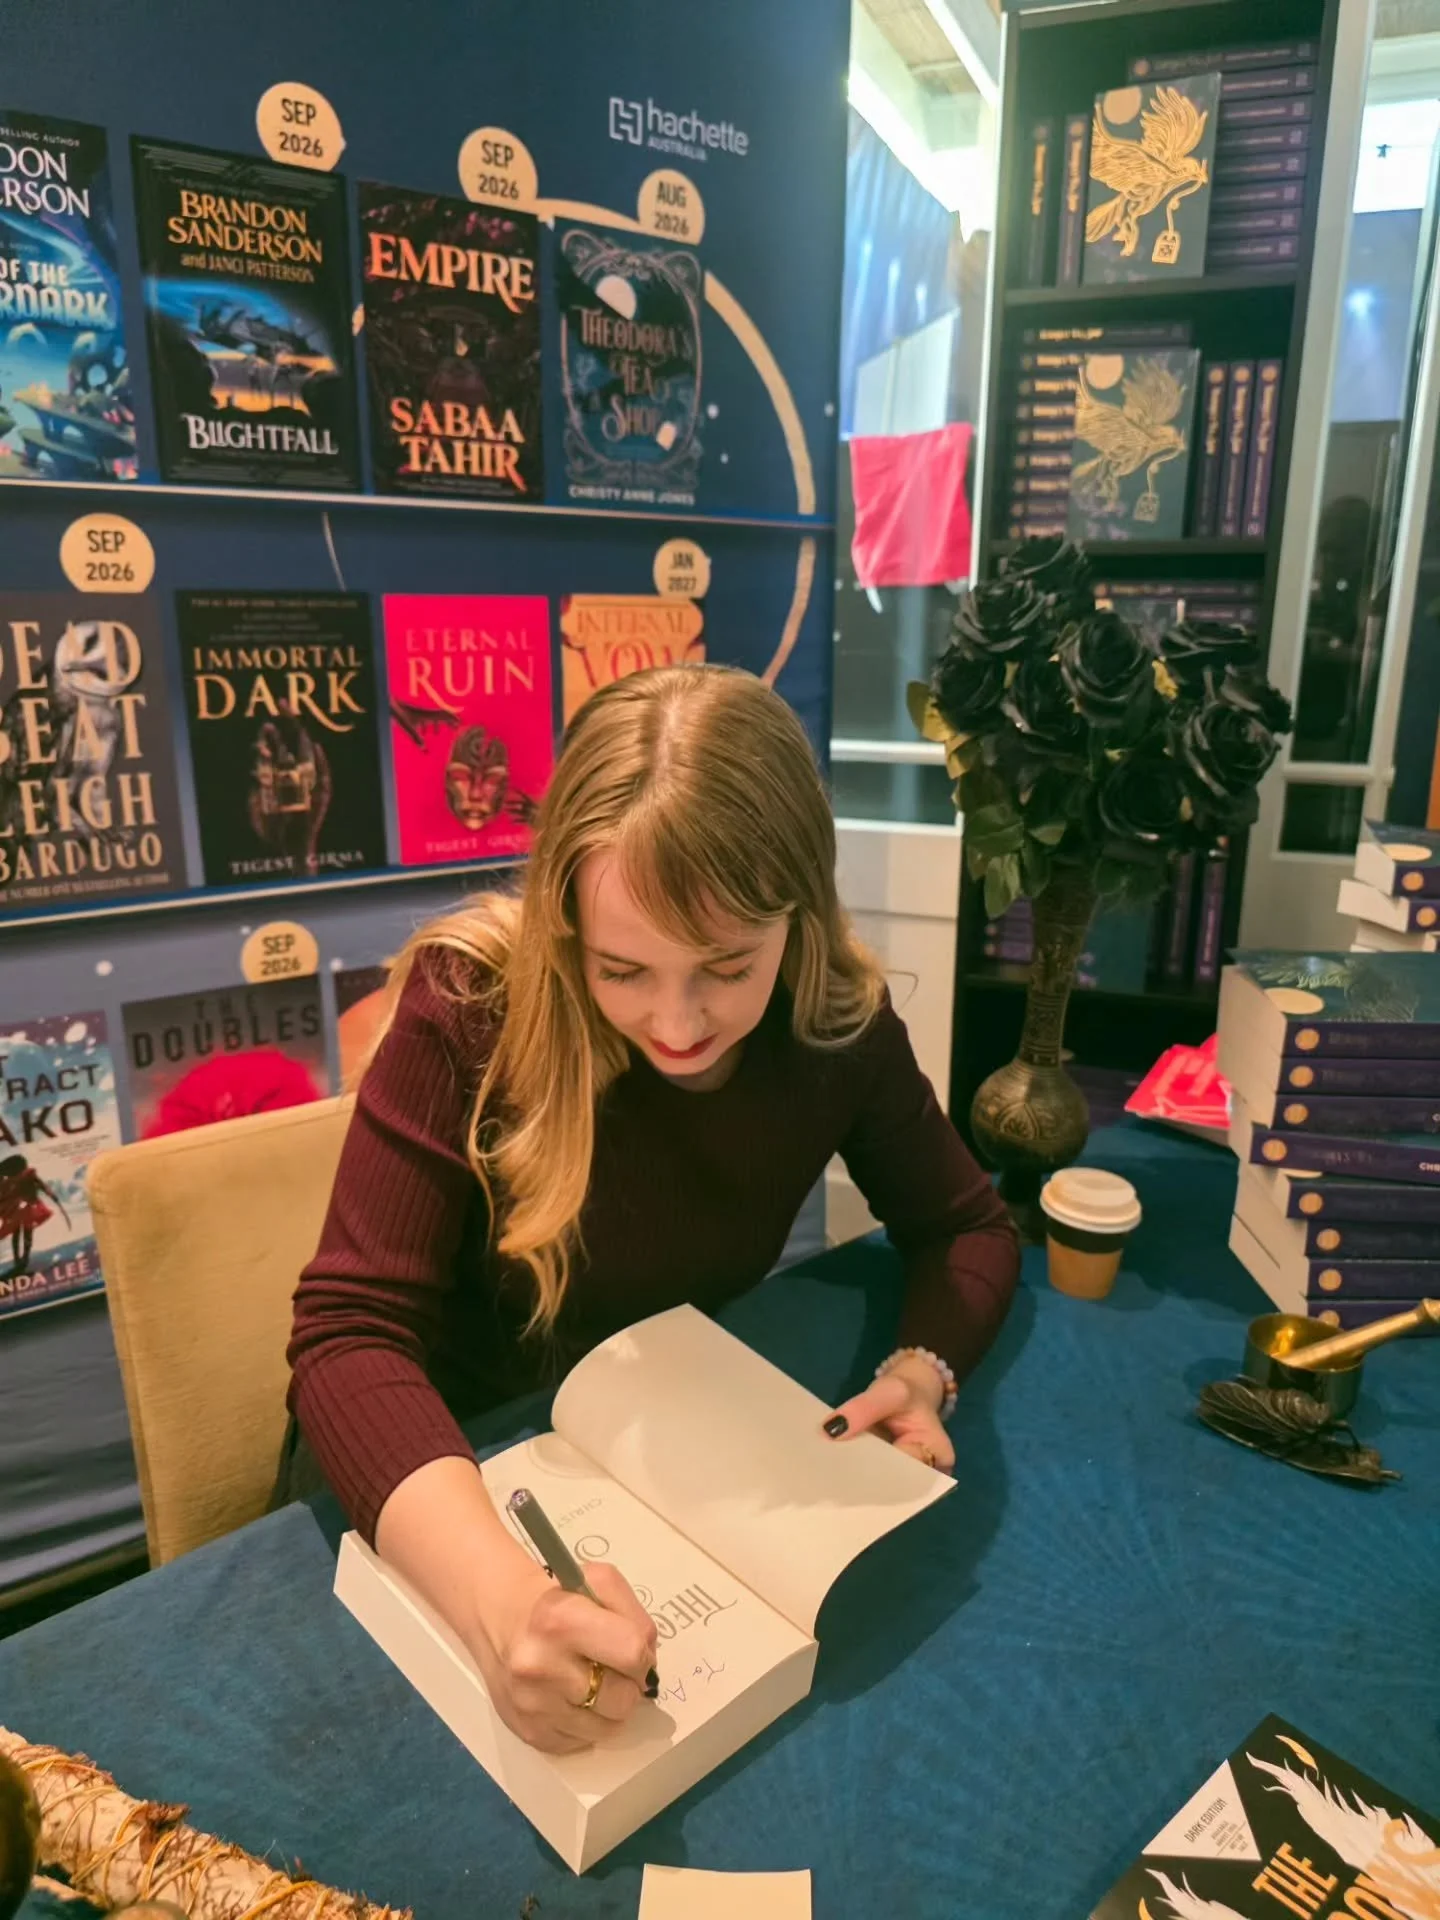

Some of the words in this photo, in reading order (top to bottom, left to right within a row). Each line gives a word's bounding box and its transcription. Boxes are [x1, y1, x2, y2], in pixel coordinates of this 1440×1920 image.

[281, 98, 316, 127] SEP
[648, 98, 749, 156] hachette
[278, 131, 324, 158] 2026
[482, 140, 514, 169] SEP
[648, 137, 707, 161] AUSTRALIA
[0, 177, 90, 218] RSON
[478, 174, 520, 200] 2026
[656, 181, 687, 208] AUG
[180, 189, 307, 233] BRANDON
[654, 211, 690, 236] 2026
[168, 216, 323, 263] SANDERSON
[28, 261, 68, 287] THE
[181, 253, 206, 269] and
[208, 254, 244, 275] JANCI
[246, 259, 315, 283] PATTERSON
[368, 231, 535, 314] EMPIRE
[181, 412, 339, 455] BLIGHTFALL
[390, 397, 526, 444] SABAA
[399, 435, 527, 492] TAHIR
[568, 484, 621, 500] CHRISTY
[623, 488, 655, 503] ANNE
[657, 491, 695, 505] JONES
[87, 530, 126, 553] SEP
[85, 563, 135, 582] 2026
[670, 552, 694, 570] JAN
[668, 576, 697, 592] 2027
[406, 627, 532, 652] ETERNAL
[193, 645, 363, 670] IMMORTAL
[408, 655, 534, 714] RUIN
[194, 670, 367, 733] DARK
[231, 856, 294, 875] TIGEST
[262, 933, 296, 957] SEP
[260, 957, 302, 976] 2026
[194, 991, 257, 1020] THE
[133, 1003, 320, 1069] DOUBLES
[0, 1063, 100, 1101] RACT
[53, 1258, 90, 1281] LEE
[654, 1583, 738, 1648] THEO
[692, 1657, 726, 1682] To
[1183, 1819, 1206, 1844] DARK
[1201, 1797, 1228, 1828] EDITION
[1252, 1842, 1339, 1920] THE
